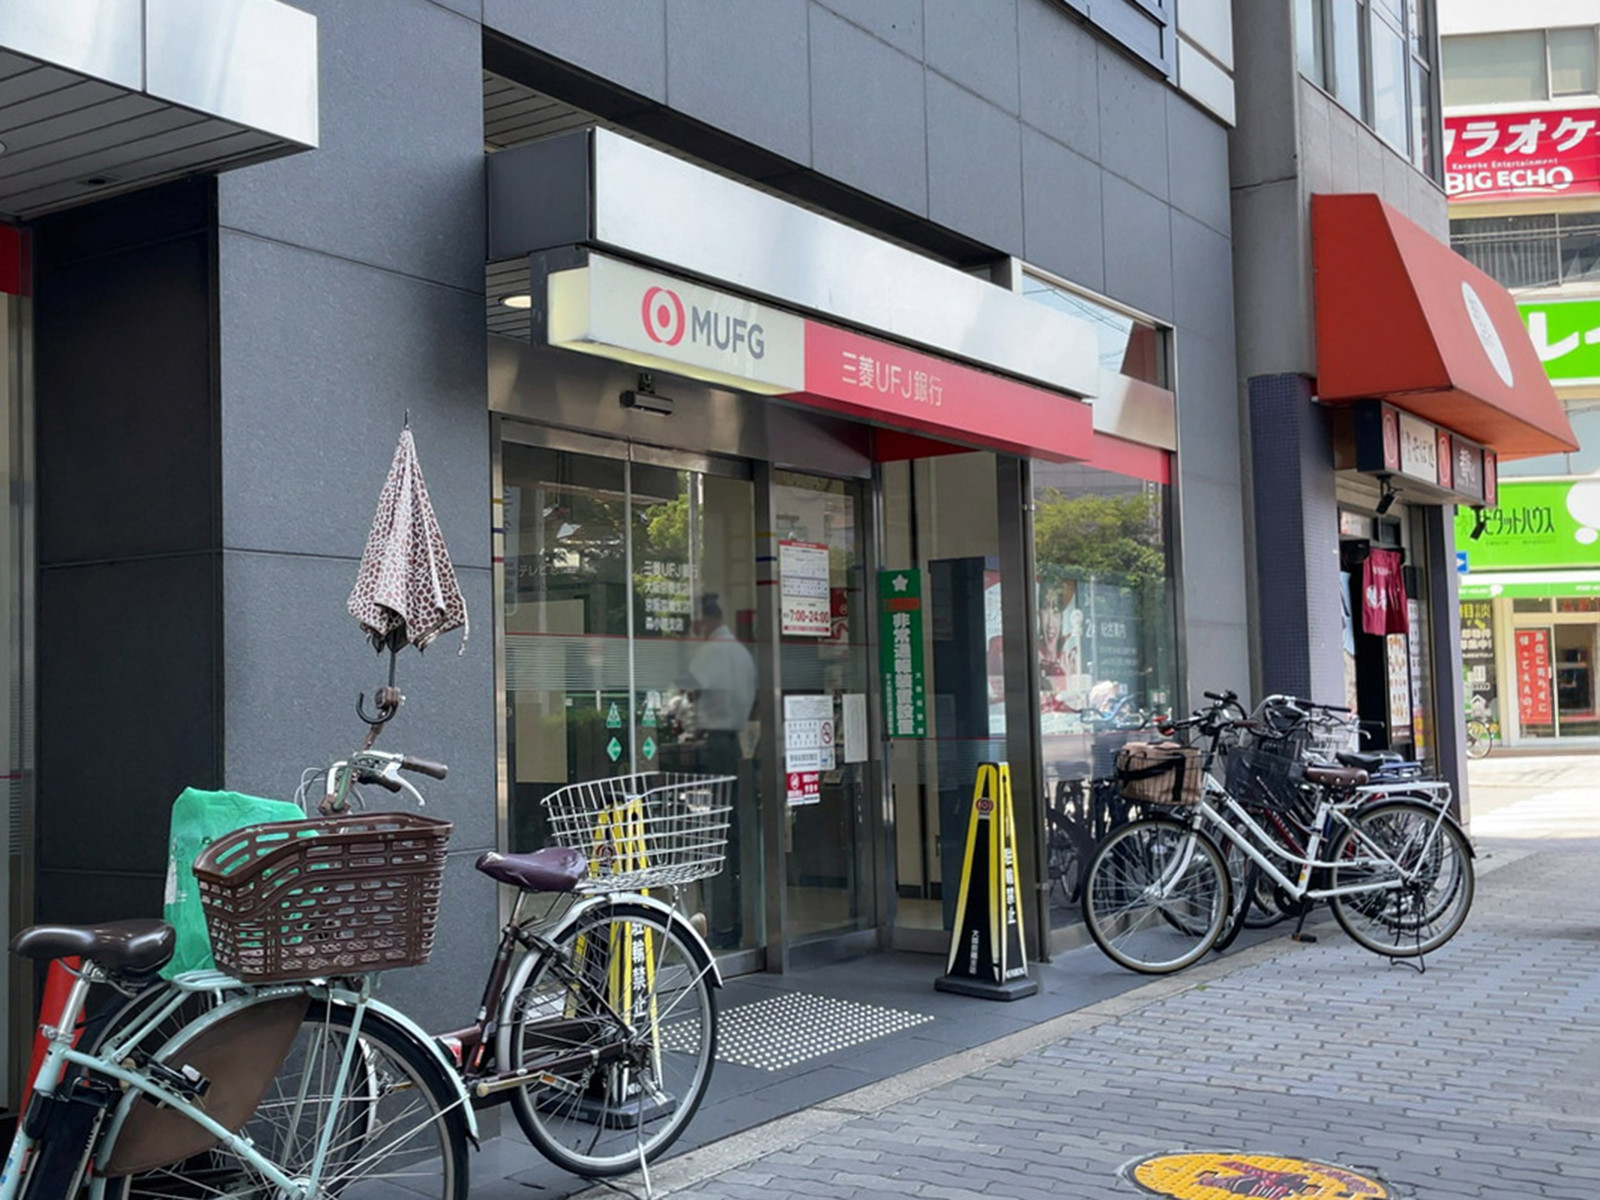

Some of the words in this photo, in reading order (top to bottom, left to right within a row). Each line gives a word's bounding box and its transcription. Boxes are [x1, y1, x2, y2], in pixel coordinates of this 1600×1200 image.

[1446, 171, 1492, 195] BIG
[1497, 166, 1574, 189] ECHO
[691, 306, 765, 360] MUFG
[842, 351, 942, 406] 三菱UFJ銀行
